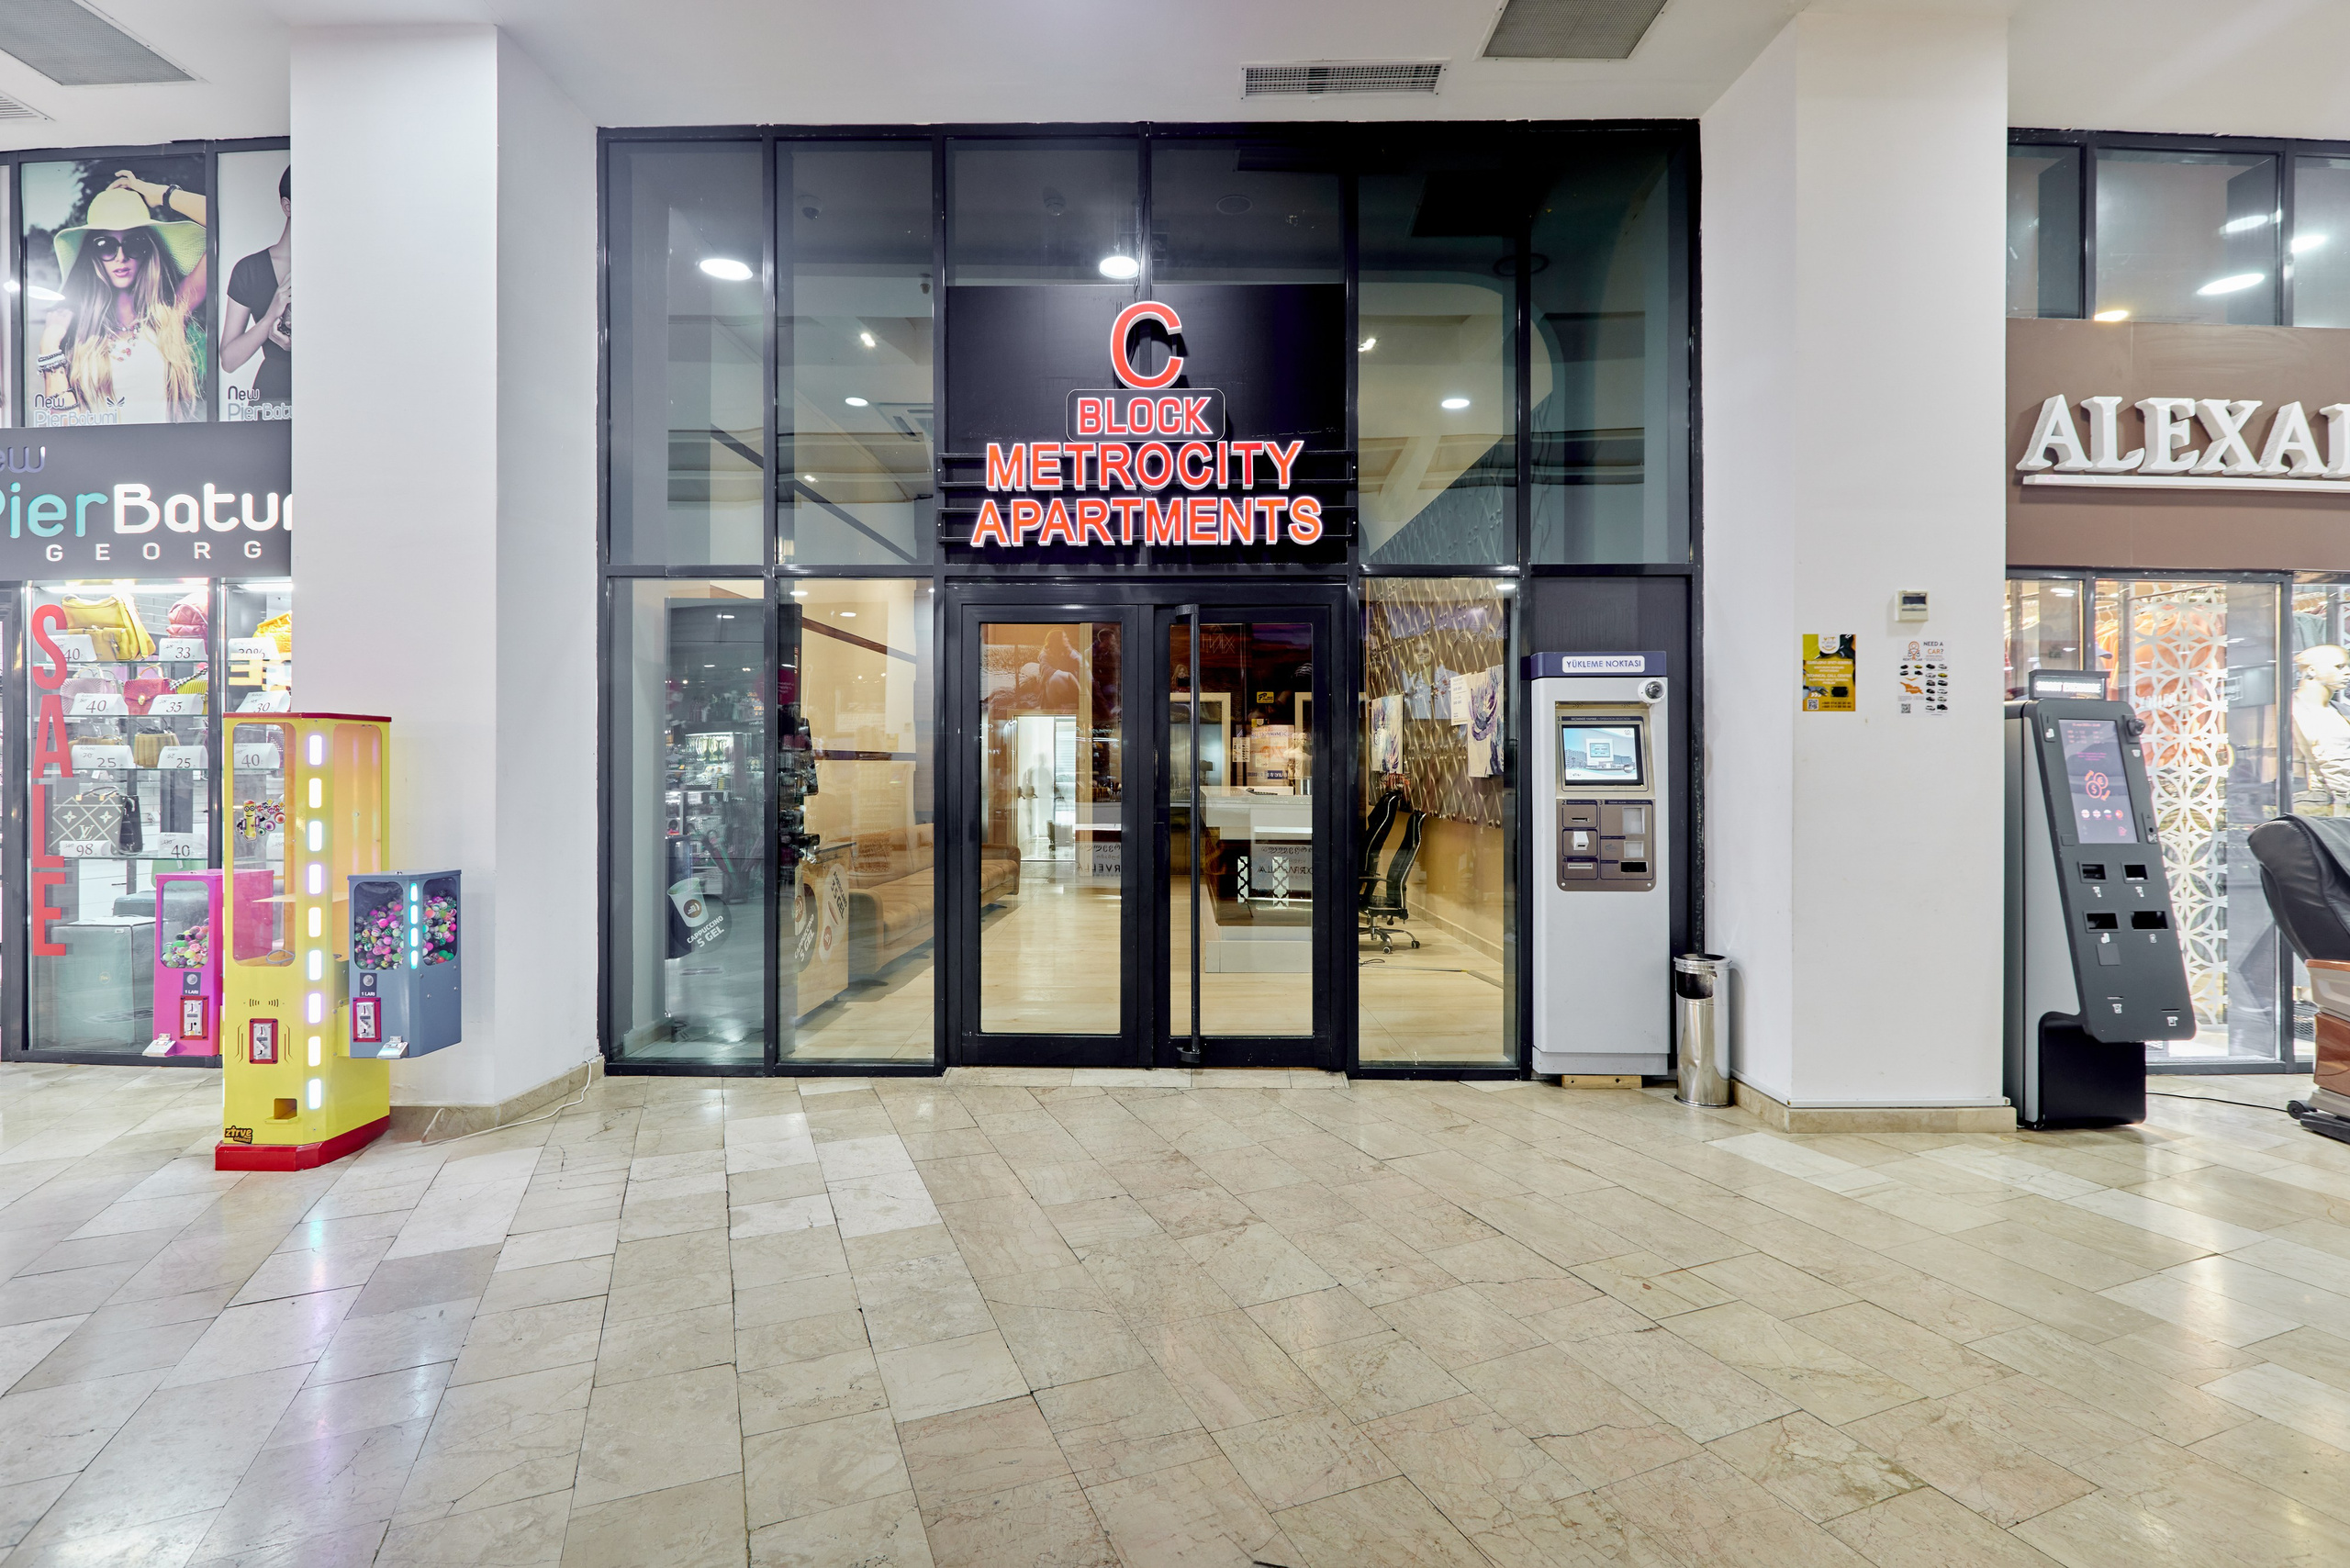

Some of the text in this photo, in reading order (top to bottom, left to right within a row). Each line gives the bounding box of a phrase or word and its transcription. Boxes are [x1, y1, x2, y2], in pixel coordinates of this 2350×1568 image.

[1110, 300, 1184, 390] C
[228, 386, 260, 400] New
[34, 394, 65, 408] New
[34, 409, 118, 426] PierBatumi
[227, 402, 292, 420] PierBat
[1077, 396, 1214, 435] BLOCK
[985, 440, 1304, 492] METROCITY
[970, 496, 1323, 547] APARTMENTS
[63, 648, 81, 662] 40
[175, 647, 191, 659] 33
[1566, 659, 1641, 668] YÜKLEME NOKTASI
[85, 700, 106, 713] 40
[166, 701, 183, 713] 35
[254, 702, 271, 712] 30
[96, 757, 117, 767] 25
[176, 757, 191, 768] 25
[241, 754, 260, 767] 40
[31, 603, 74, 957] SALE
[76, 843, 94, 857] 98
[171, 845, 190, 858] 40
[687, 915, 724, 944] CAPPUCCINO
[697, 925, 725, 947] 5 GEL
[794, 913, 814, 959] CAPPUCCINO
[800, 930, 815, 962] 5 GEL
